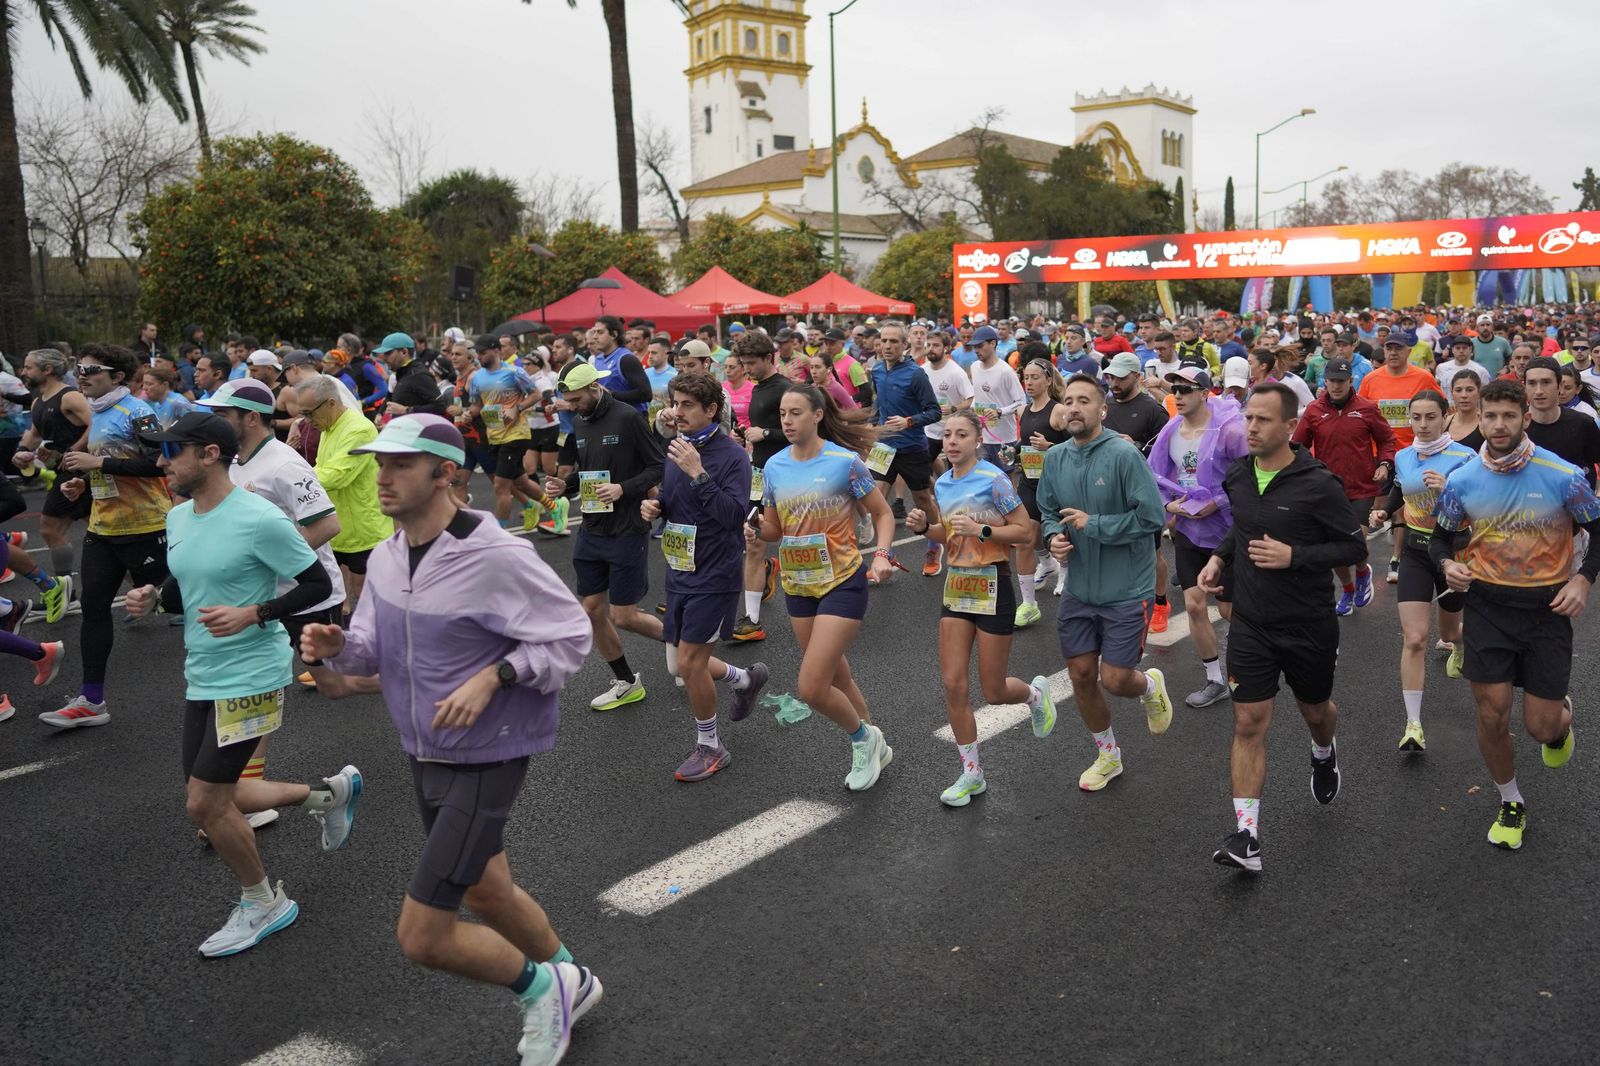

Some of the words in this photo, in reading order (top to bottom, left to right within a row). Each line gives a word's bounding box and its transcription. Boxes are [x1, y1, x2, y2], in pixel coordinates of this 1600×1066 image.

[1367, 238, 1422, 257] HOKA
[1106, 250, 1150, 267] HOKA
[1381, 405, 1407, 416] 12632
[297, 490, 321, 505] MGS
[663, 532, 689, 551] 12934
[783, 548, 818, 564] 11597
[949, 576, 989, 593] 10279
